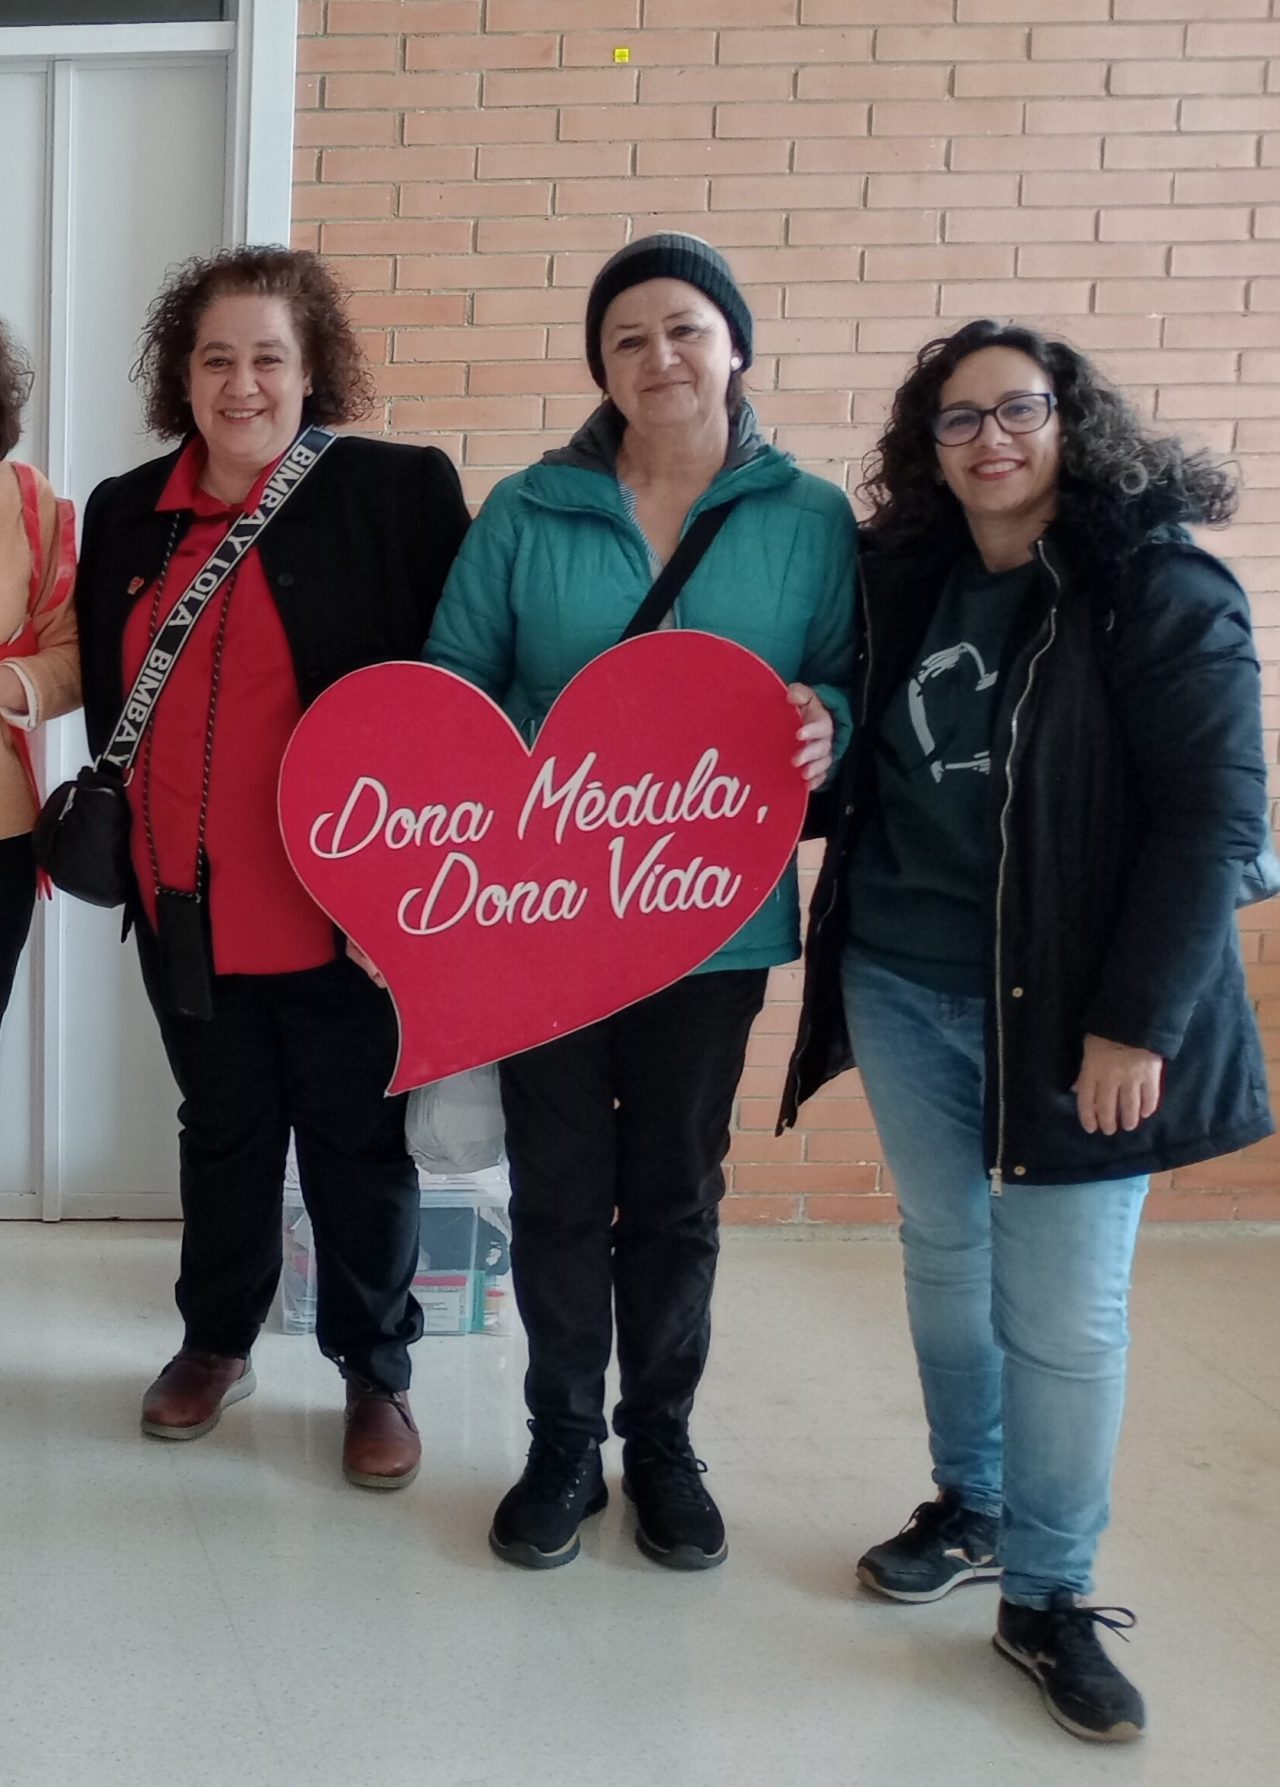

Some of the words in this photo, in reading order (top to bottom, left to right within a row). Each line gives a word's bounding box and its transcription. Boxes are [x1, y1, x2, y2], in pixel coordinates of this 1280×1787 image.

[238, 442, 317, 525] BIMBA
[225, 533, 250, 554] Y
[168, 557, 229, 627] LOLA
[115, 648, 173, 741] BIMBA
[309, 777, 494, 858] Dona
[397, 852, 588, 935] Dona
[608, 832, 742, 919] Vida
